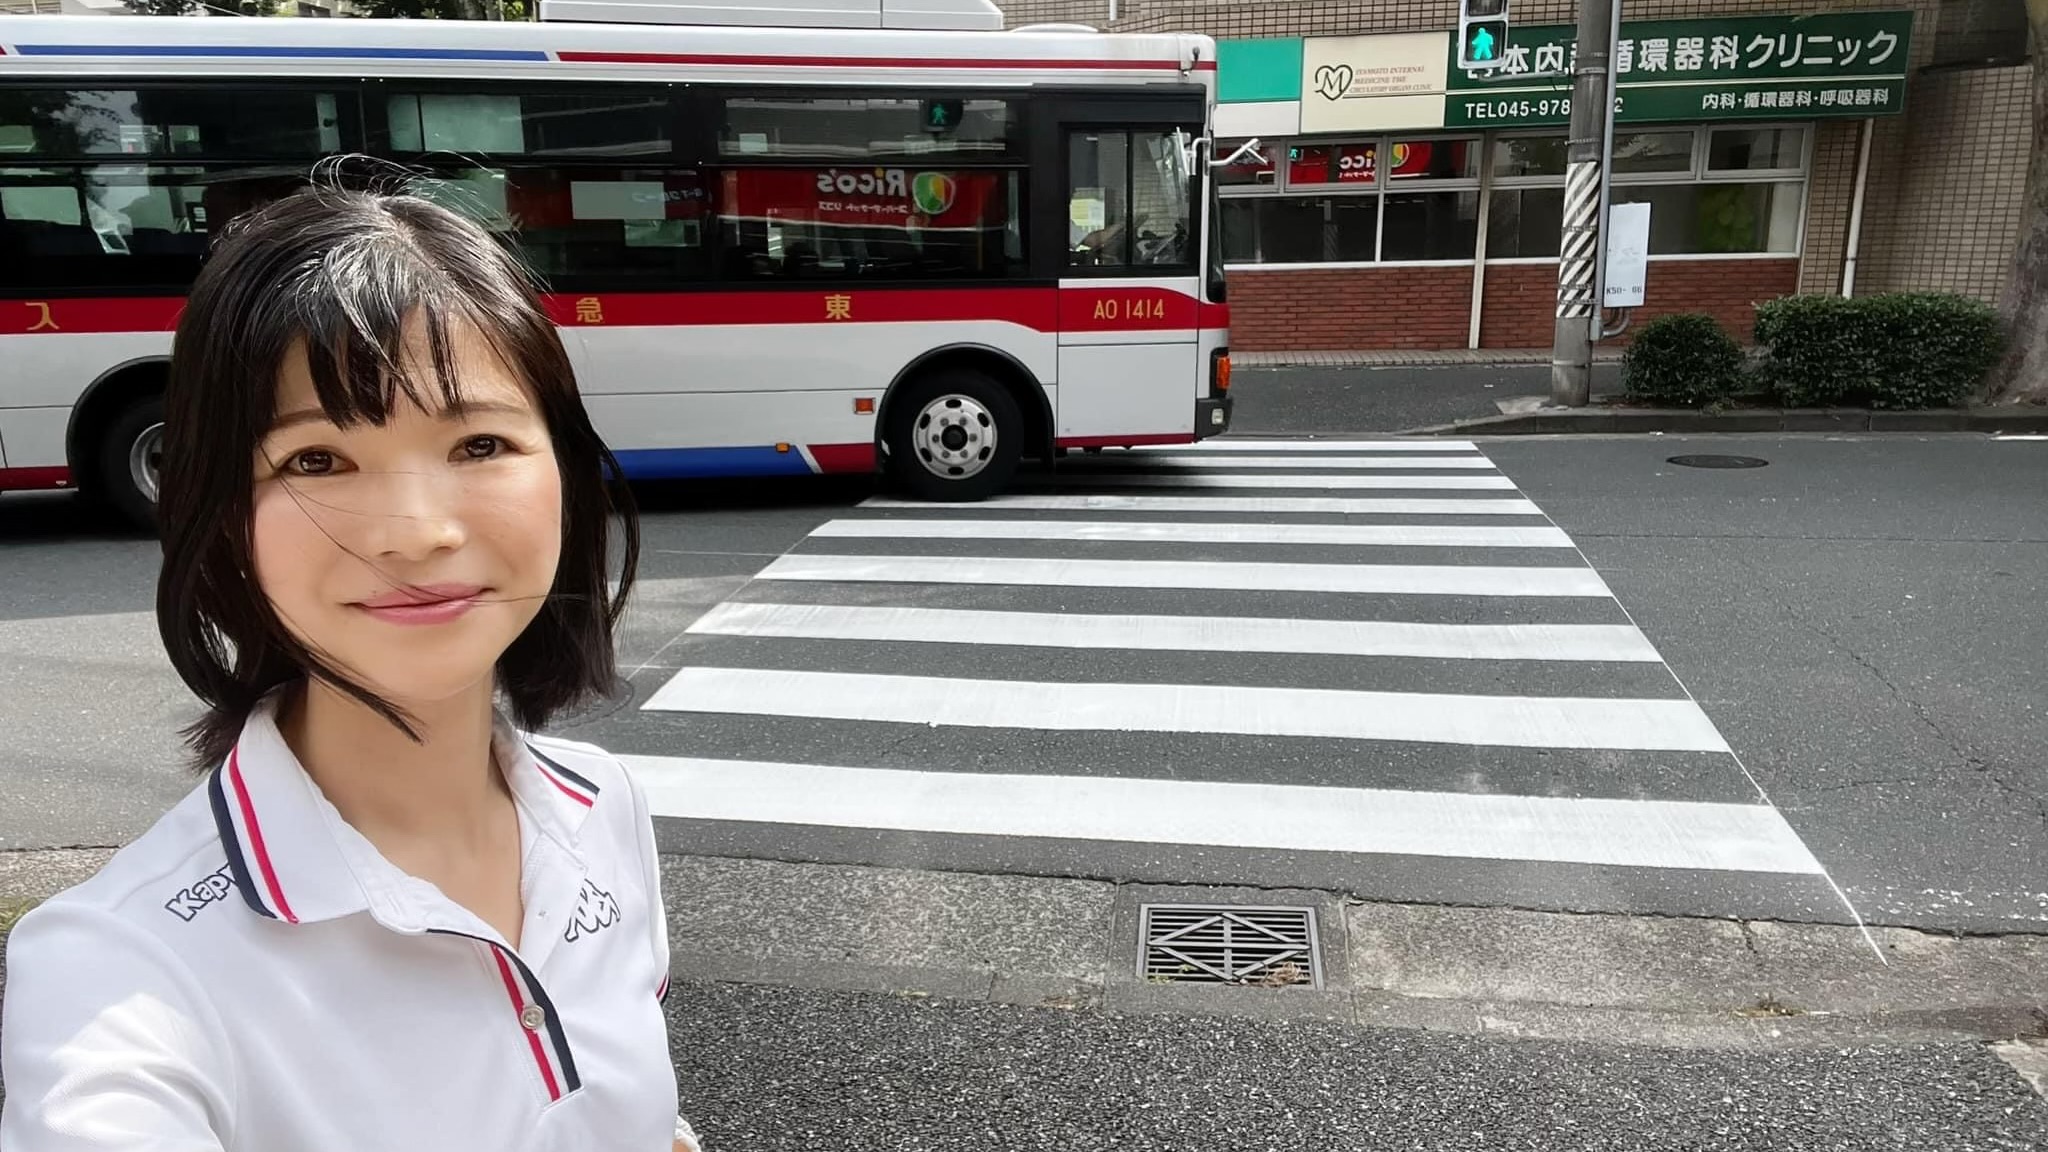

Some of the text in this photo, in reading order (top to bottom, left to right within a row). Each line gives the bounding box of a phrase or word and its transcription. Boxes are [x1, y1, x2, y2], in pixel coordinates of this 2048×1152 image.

[1467, 30, 1898, 79] 本内循環器科クリニック
[576, 297, 603, 323] 急
[824, 294, 851, 319] 東
[1126, 299, 1164, 319] 1414
